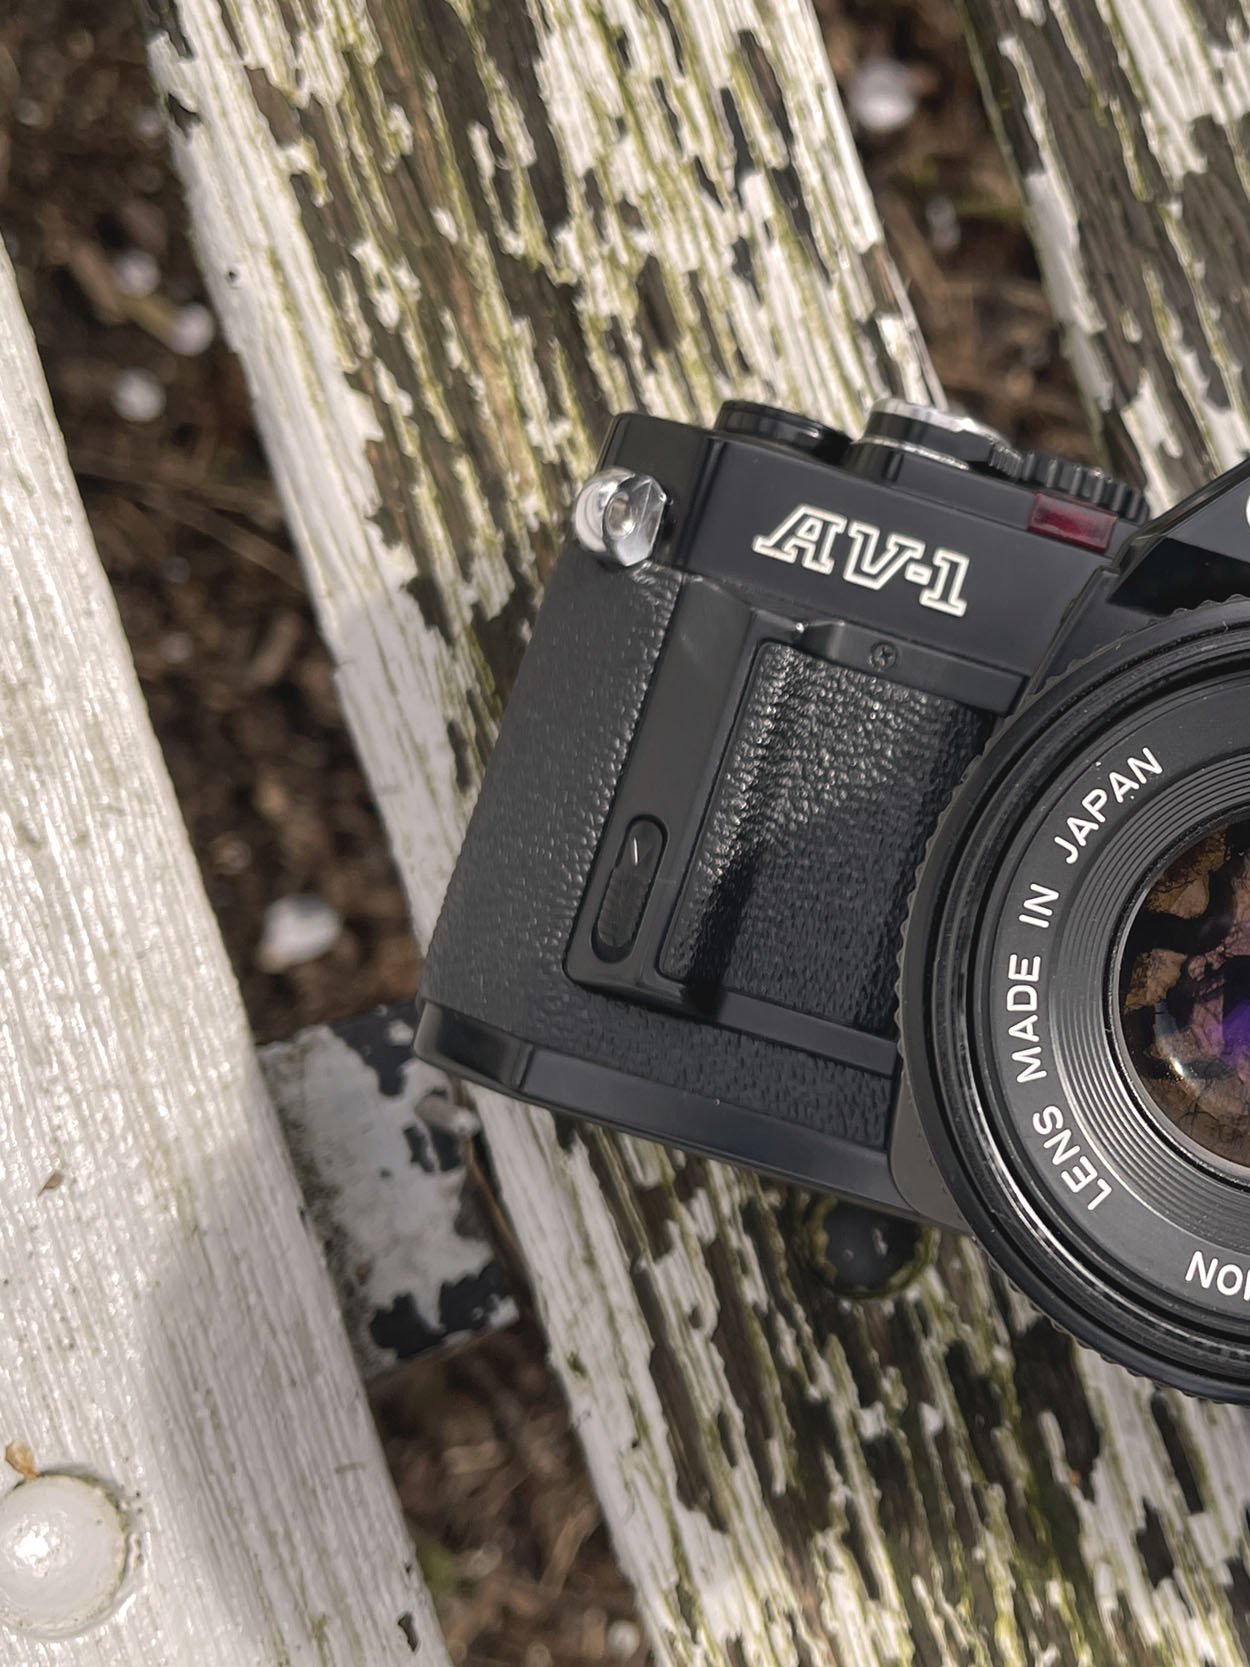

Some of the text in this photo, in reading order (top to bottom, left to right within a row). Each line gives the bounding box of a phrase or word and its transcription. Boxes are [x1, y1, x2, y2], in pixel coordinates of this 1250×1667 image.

[752, 504, 970, 617] AV-1
[1006, 747, 1163, 1211] LENS MADE IN JAPAN
